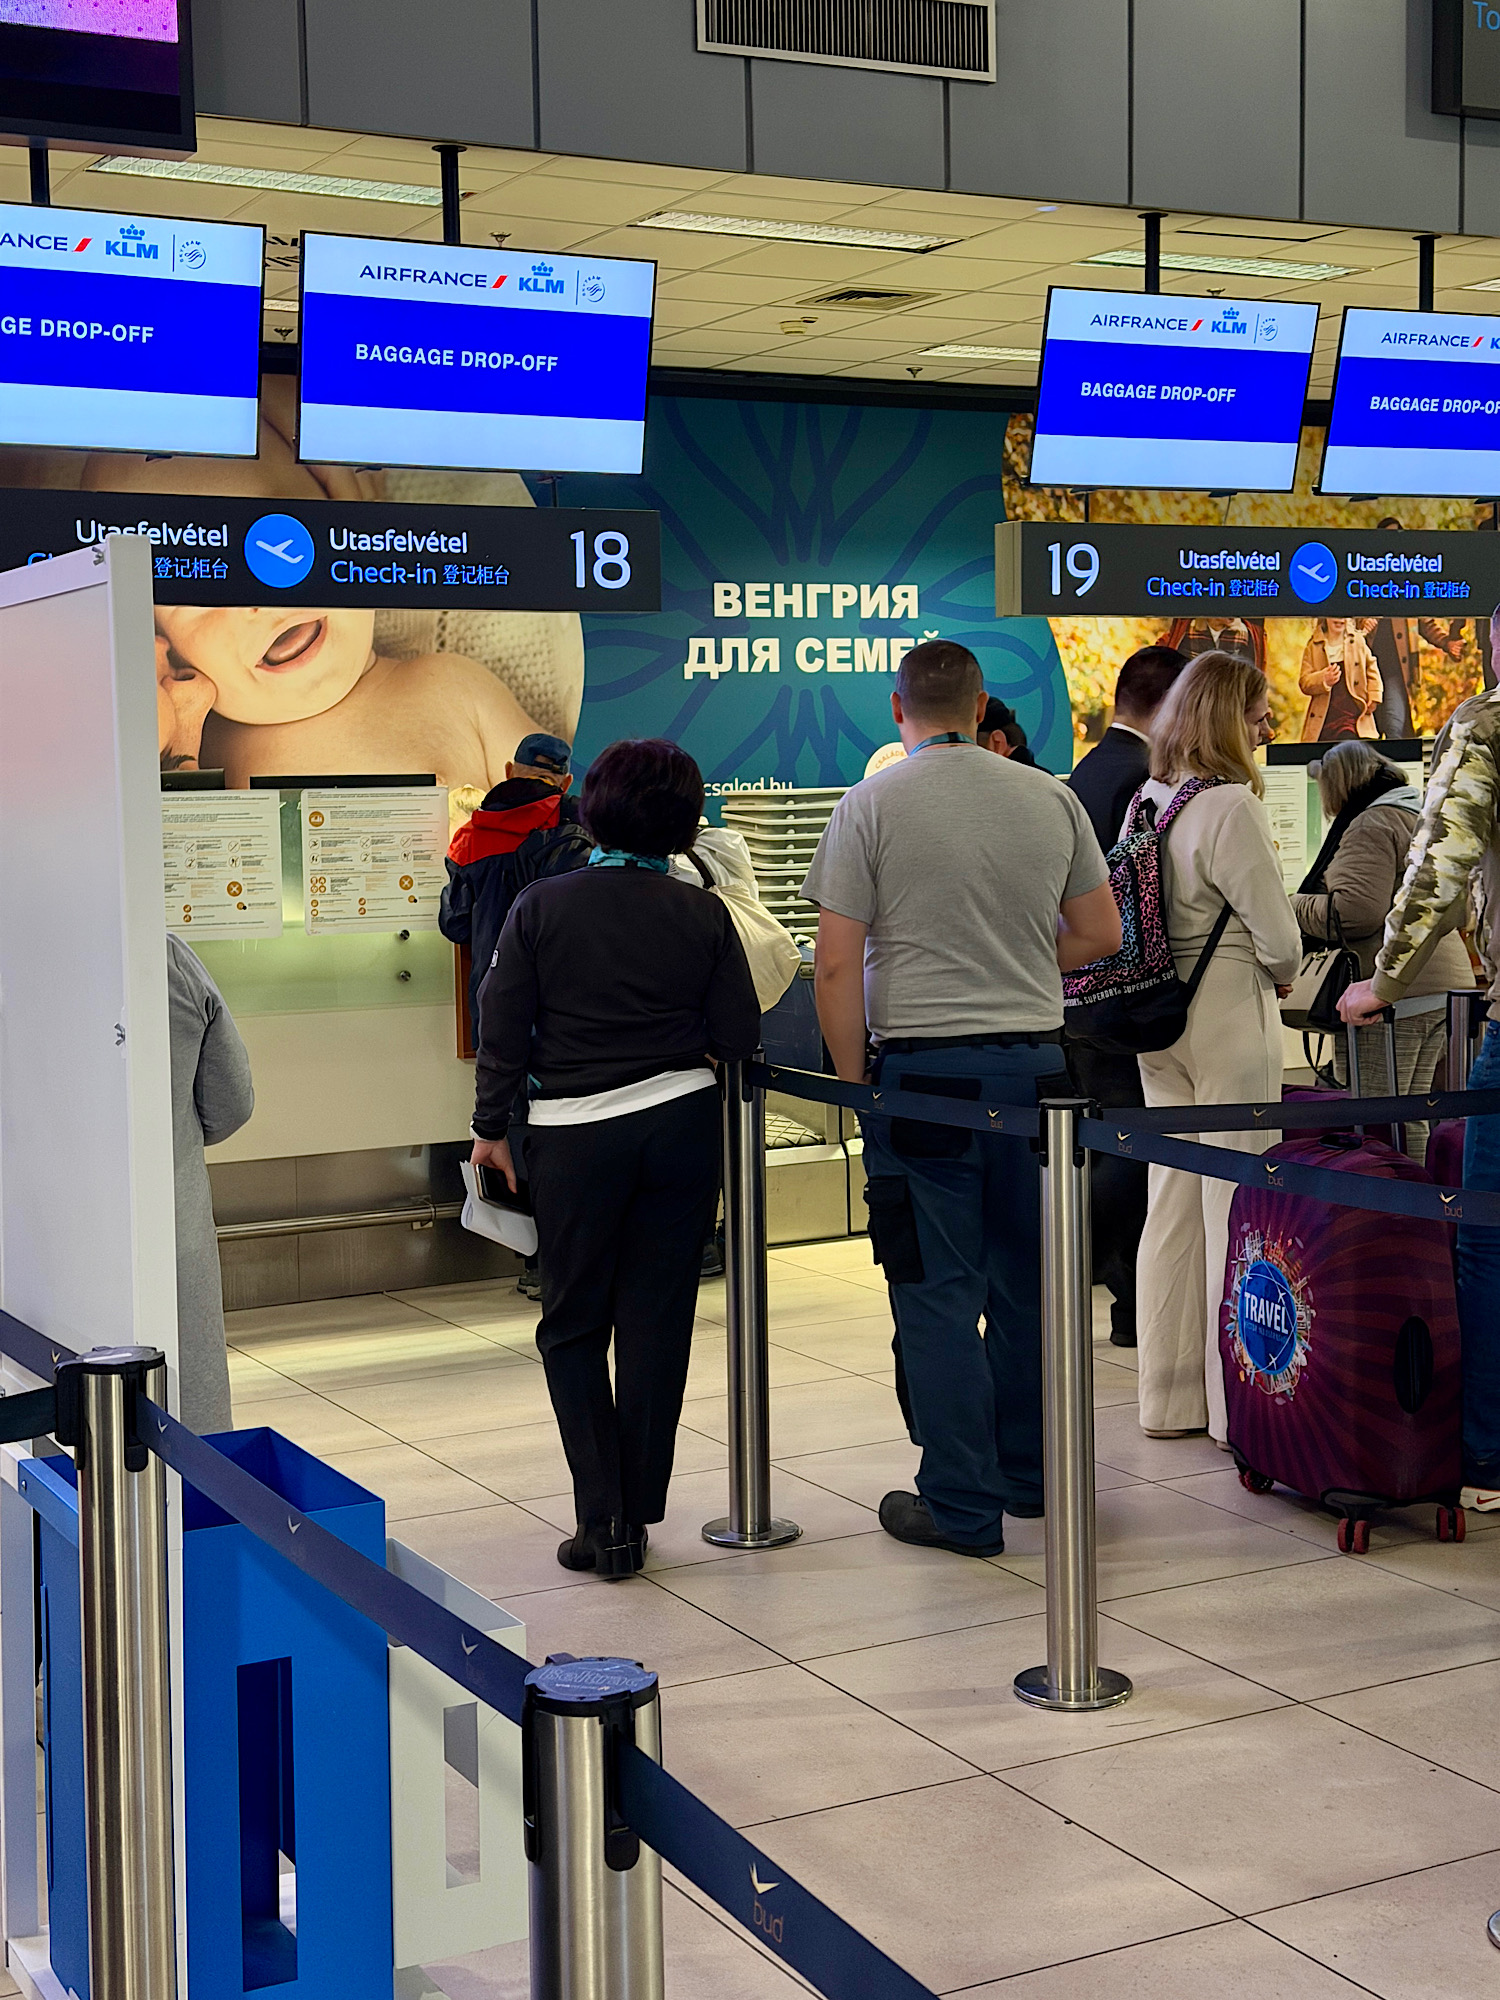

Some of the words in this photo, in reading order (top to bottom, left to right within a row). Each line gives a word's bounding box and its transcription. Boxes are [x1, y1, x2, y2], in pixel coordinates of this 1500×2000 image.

[0, 232, 68, 252] ANCE
[105, 240, 159, 260] KLM
[359, 264, 487, 288] AIRFRANCE
[518, 276, 565, 294] KLM
[0, 316, 32, 336] GE
[40, 319, 154, 344] DROP-OFF
[1090, 313, 1188, 331] AIRFRANCE
[1211, 320, 1247, 335] KLM
[1381, 332, 1470, 348] AIRFRANCE
[355, 343, 454, 366] BAGGAGE
[460, 350, 558, 372] DROP-OFF
[1080, 381, 1156, 399] BAGGAGE
[1160, 385, 1236, 402] DROP-OFF
[1370, 396, 1440, 412] BAGGAGE
[329, 527, 467, 553] Utasfelvétel
[153, 556, 229, 580] 登记柜台
[570, 530, 631, 589] 18
[1048, 542, 1100, 597] 19
[1179, 549, 1280, 571] Utasfelvétel
[1347, 552, 1443, 573] Utasfelvétel
[330, 560, 437, 584] Check-in
[442, 564, 510, 586] 登记柜台
[1146, 576, 1225, 597] Check-in
[1228, 579, 1280, 598] 登记柜台
[1346, 579, 1420, 598] Check-in
[713, 582, 919, 619] ВЕНГРИЯ
[684, 637, 780, 680] ДЛЯ
[795, 630, 940, 673] СЕМЕ
[1443, 1203, 1463, 1218] bud
[1244, 1291, 1289, 1335] TRAVEL
[753, 1899, 784, 1944] bud
